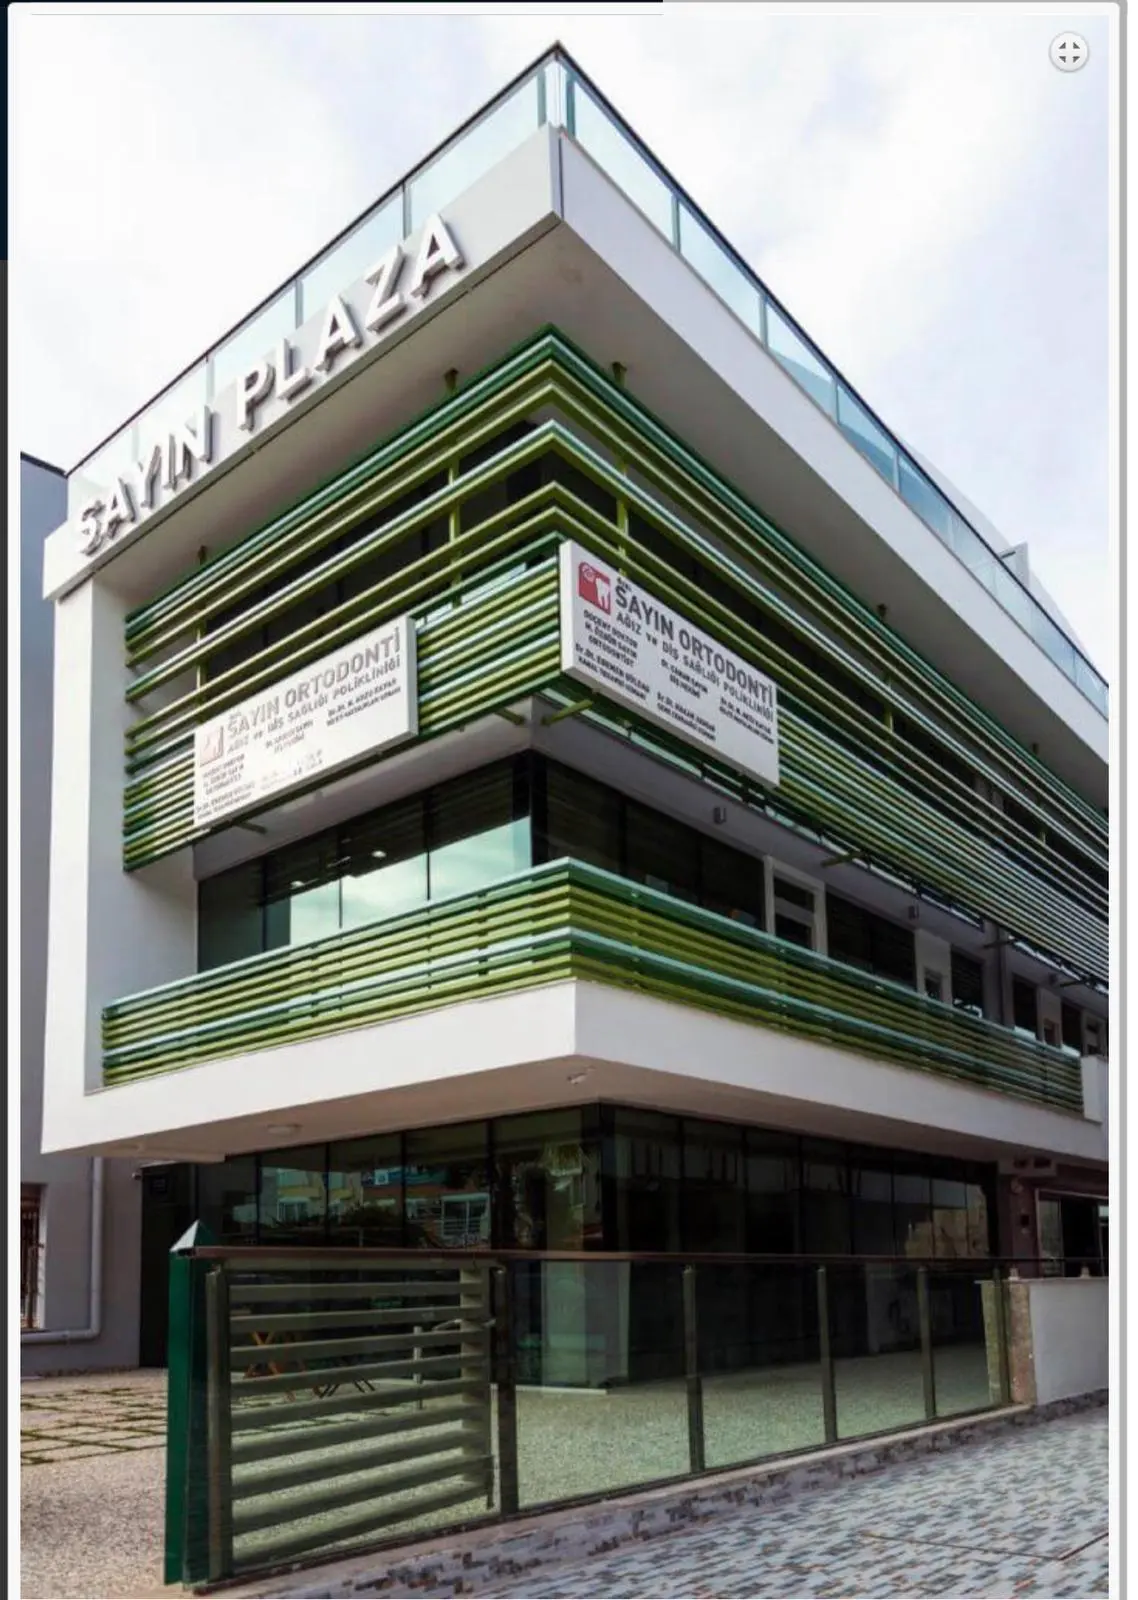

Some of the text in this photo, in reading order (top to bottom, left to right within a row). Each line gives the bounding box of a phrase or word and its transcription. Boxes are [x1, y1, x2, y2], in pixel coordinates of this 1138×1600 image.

[80, 212, 465, 556] SAYIN PLAZA
[228, 694, 279, 739] SAYIN
[284, 625, 400, 709] ORTODONTİ
[614, 582, 772, 708] SAYIN ORTODONTİ
